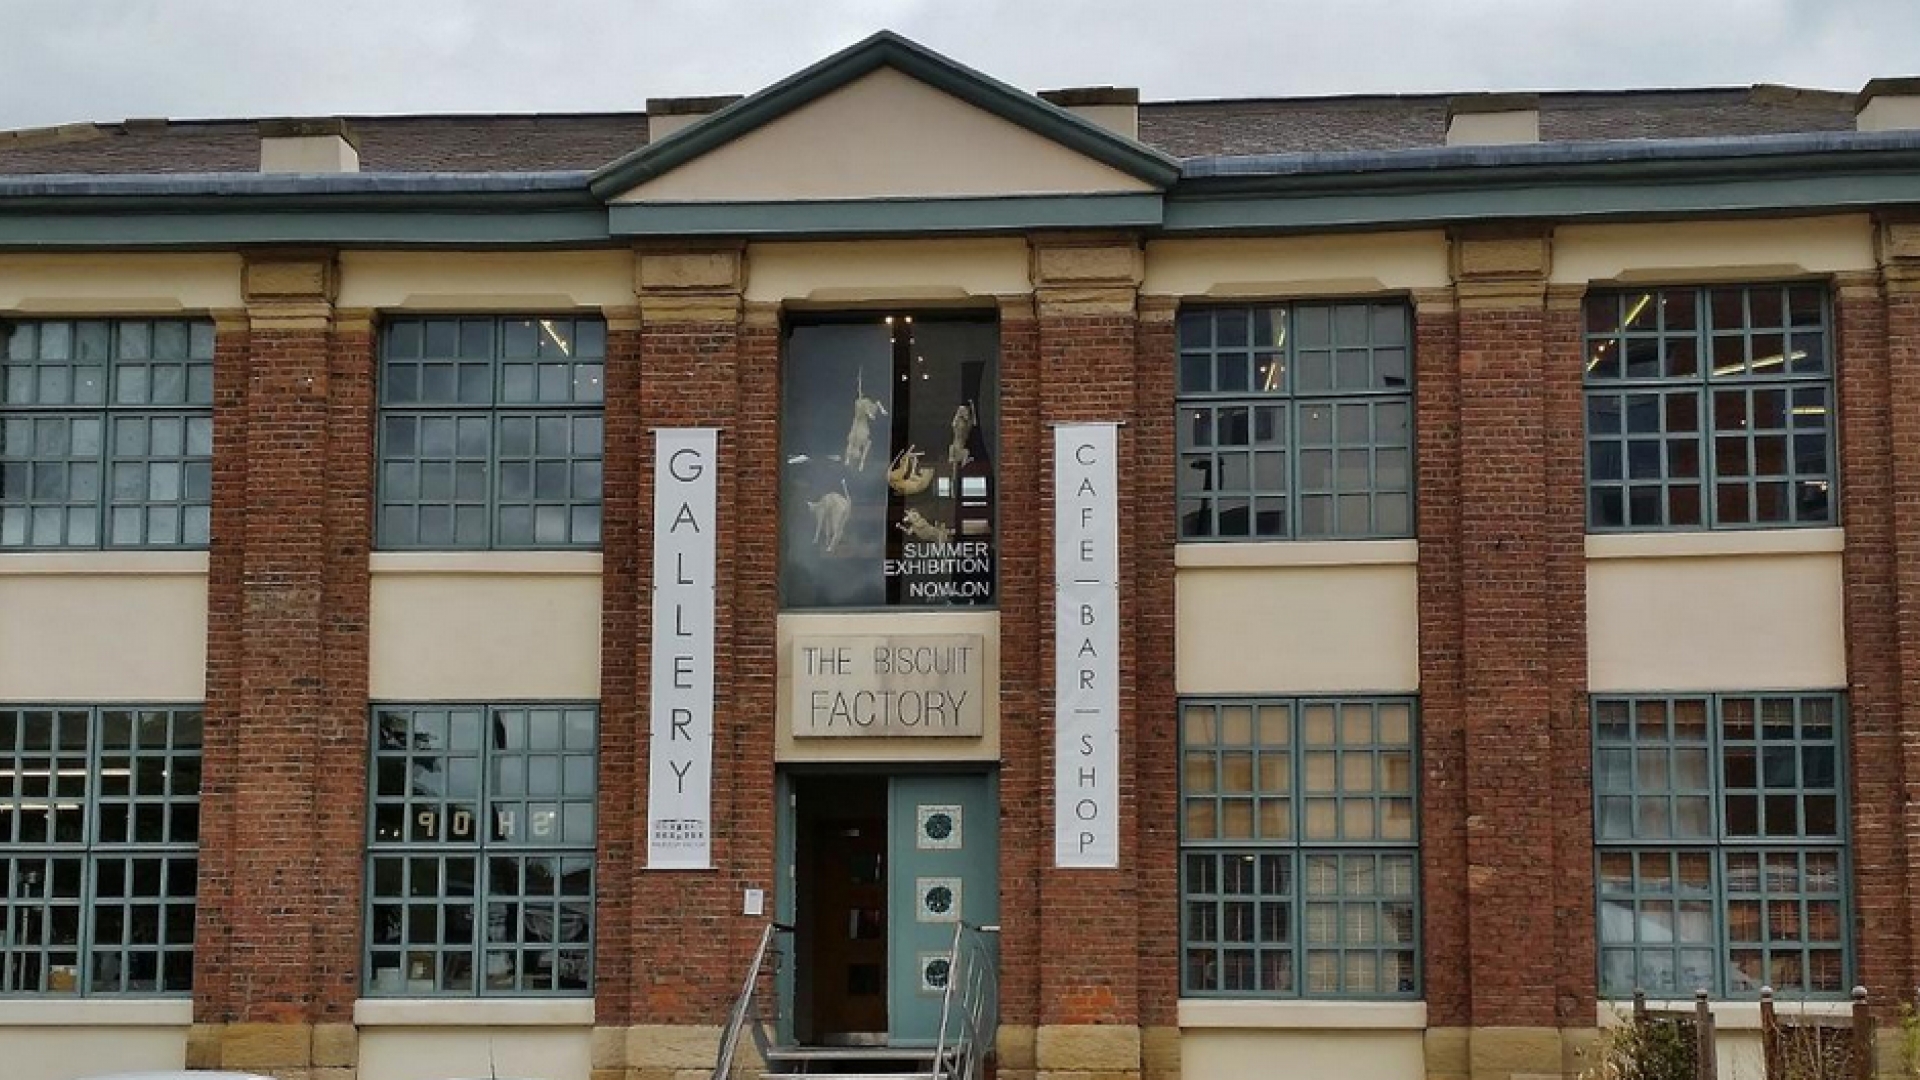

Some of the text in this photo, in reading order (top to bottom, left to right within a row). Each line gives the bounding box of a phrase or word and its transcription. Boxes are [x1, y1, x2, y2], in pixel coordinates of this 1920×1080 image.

[903, 542, 989, 559] SUMMER
[883, 558, 989, 575] EXHIBITION
[909, 581, 989, 598] NOW ON
[669, 448, 703, 794] GALLERY
[802, 647, 973, 676] THE BISCUIT
[1075, 444, 1098, 854] CAFE BAR SHOP
[811, 689, 968, 728] FACTORY
